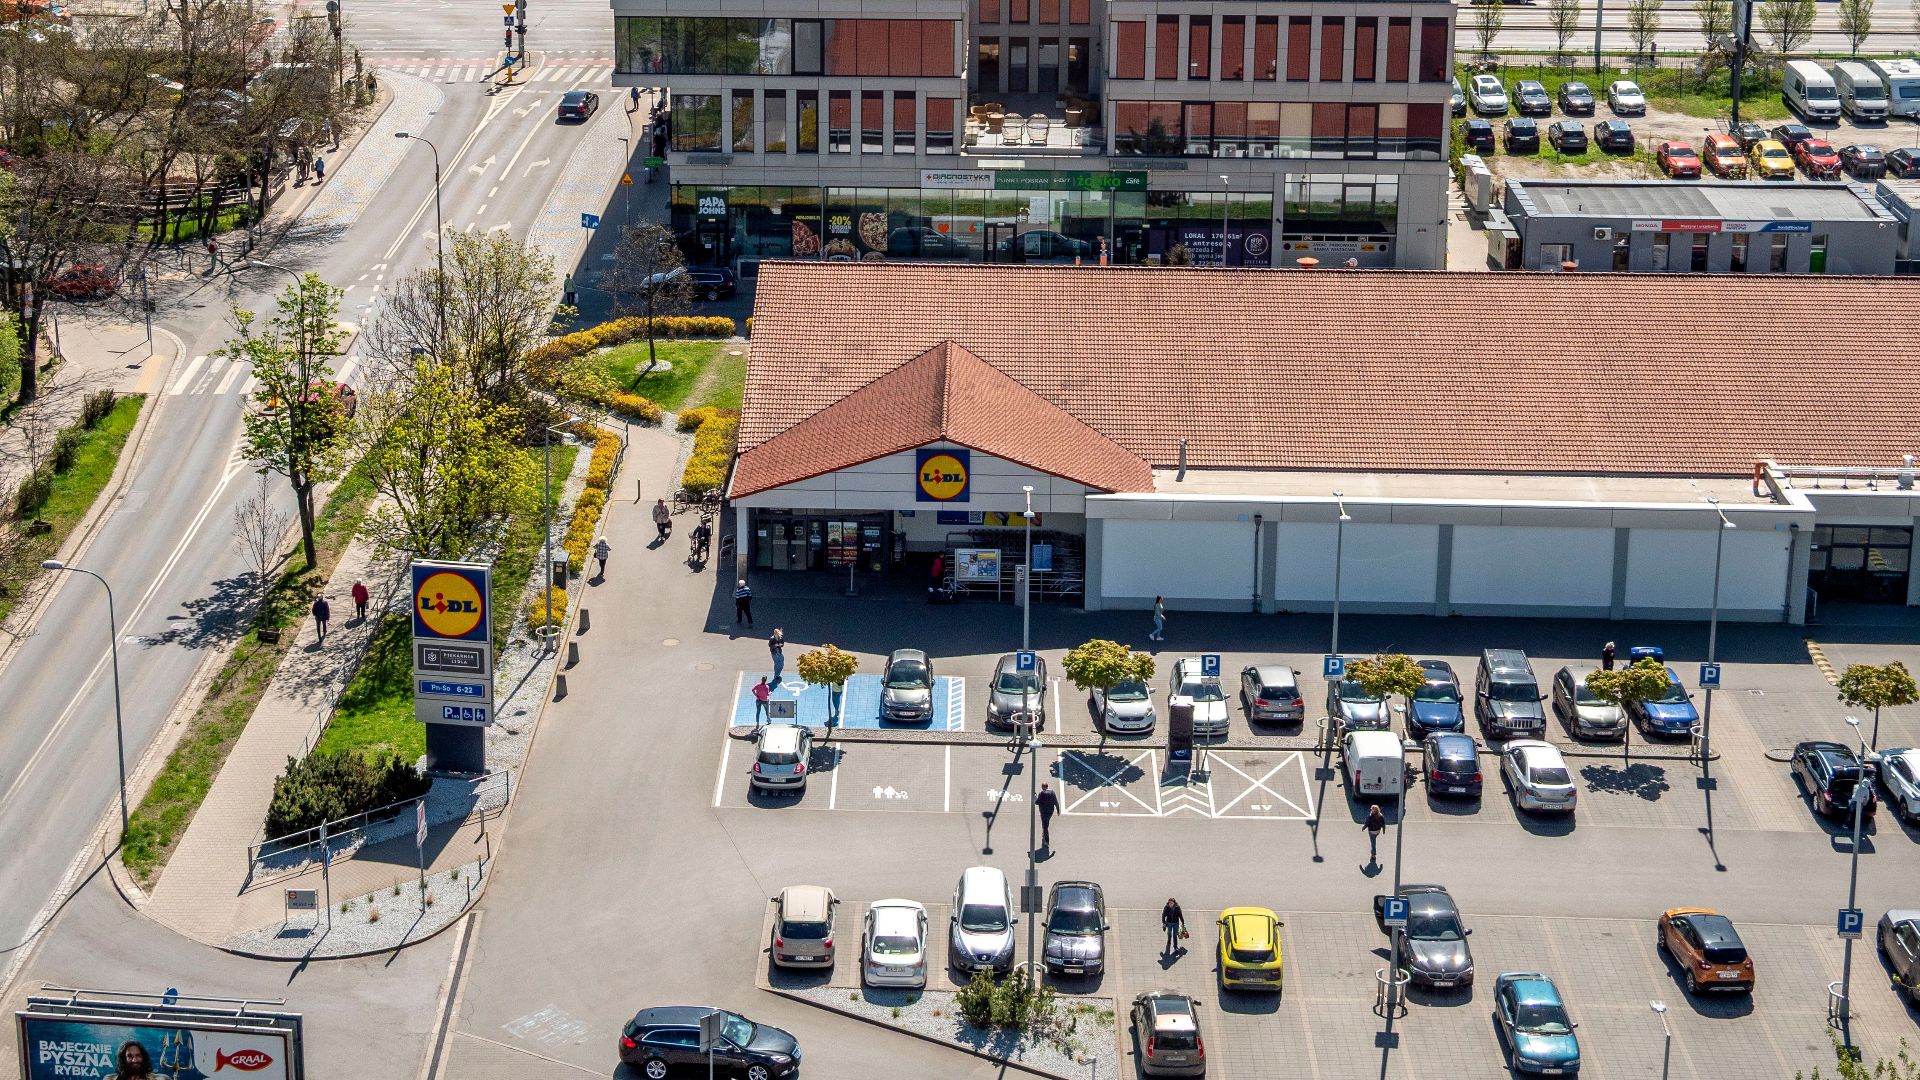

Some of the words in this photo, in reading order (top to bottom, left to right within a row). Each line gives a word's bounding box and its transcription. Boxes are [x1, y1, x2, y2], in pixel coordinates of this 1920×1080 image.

[932, 173, 991, 181] DIAGNOSTYKA
[699, 197, 726, 207] PAPA
[698, 207, 726, 215] JOHNS
[829, 215, 852, 226] -20%
[1020, 655, 1032, 669] P
[1205, 657, 1217, 671] P
[1328, 659, 1340, 673] P
[1704, 667, 1717, 682] P
[431, 684, 451, 692] Pn-So
[444, 707, 453, 718] P
[1390, 900, 1404, 917] P
[1844, 913, 1859, 930] P
[39, 1040, 113, 1054] BAJECZNIE
[40, 1050, 114, 1068] PYSZNA
[230, 1054, 267, 1066] GRAAL
[54, 1065, 101, 1078] RYBKA
